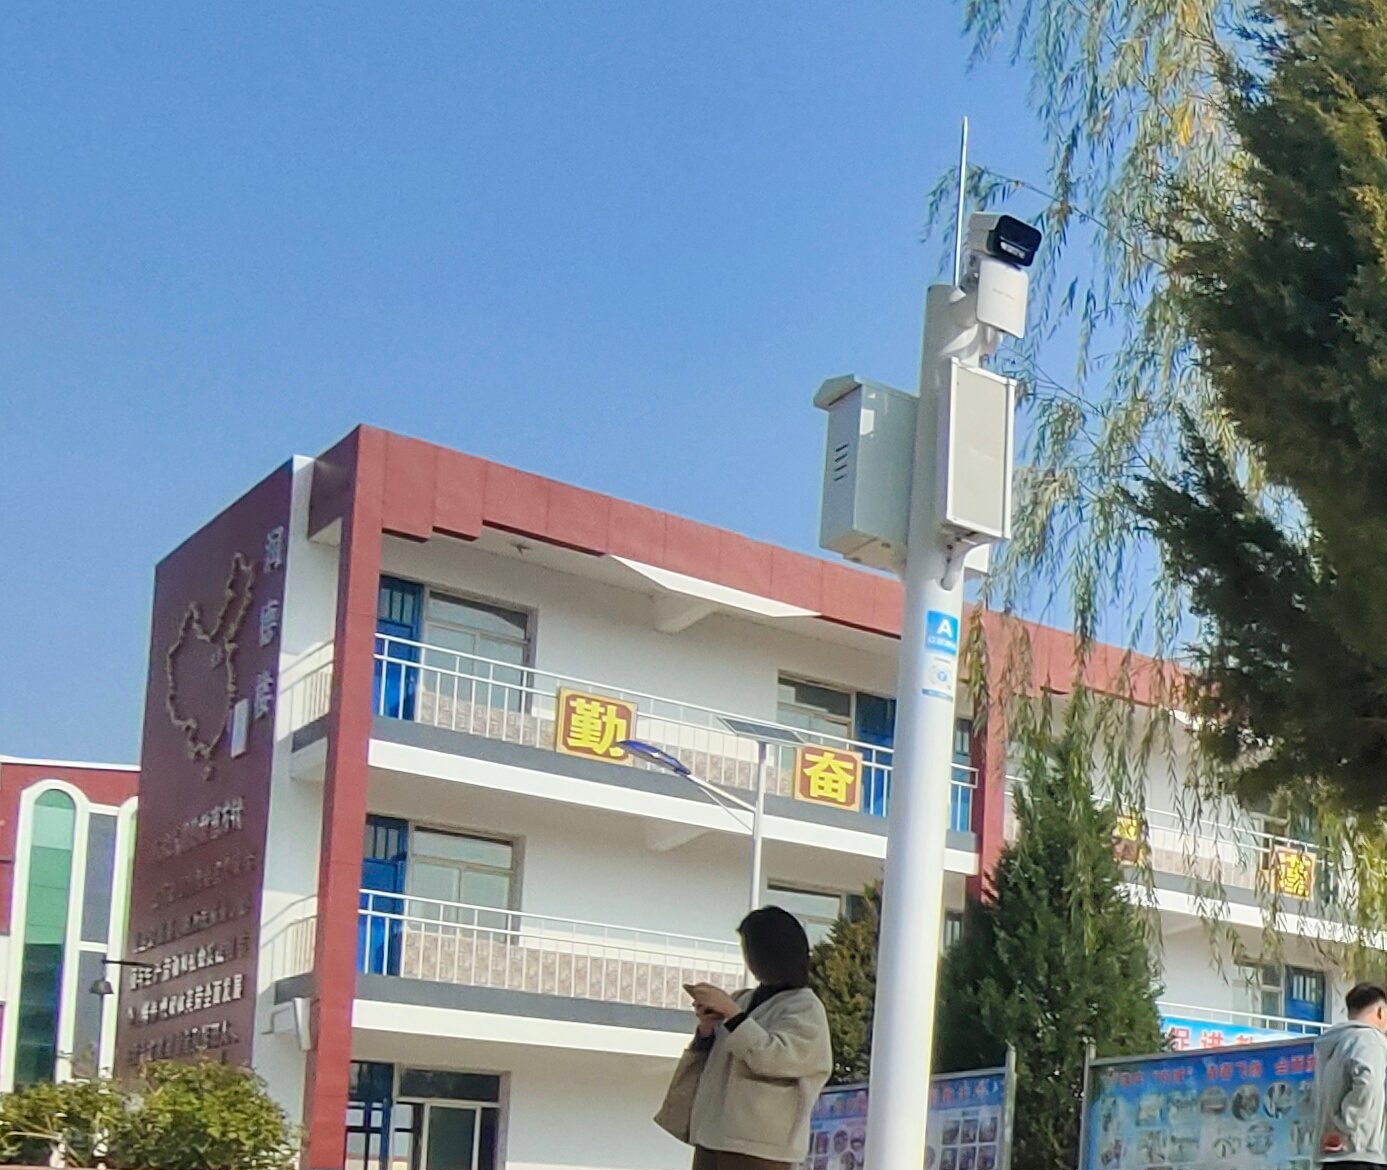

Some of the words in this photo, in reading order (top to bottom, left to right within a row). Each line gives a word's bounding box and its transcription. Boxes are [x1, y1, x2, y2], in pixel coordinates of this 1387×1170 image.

[936, 618, 953, 639] A
[569, 698, 628, 758] 勤
[803, 751, 854, 803] 奋
